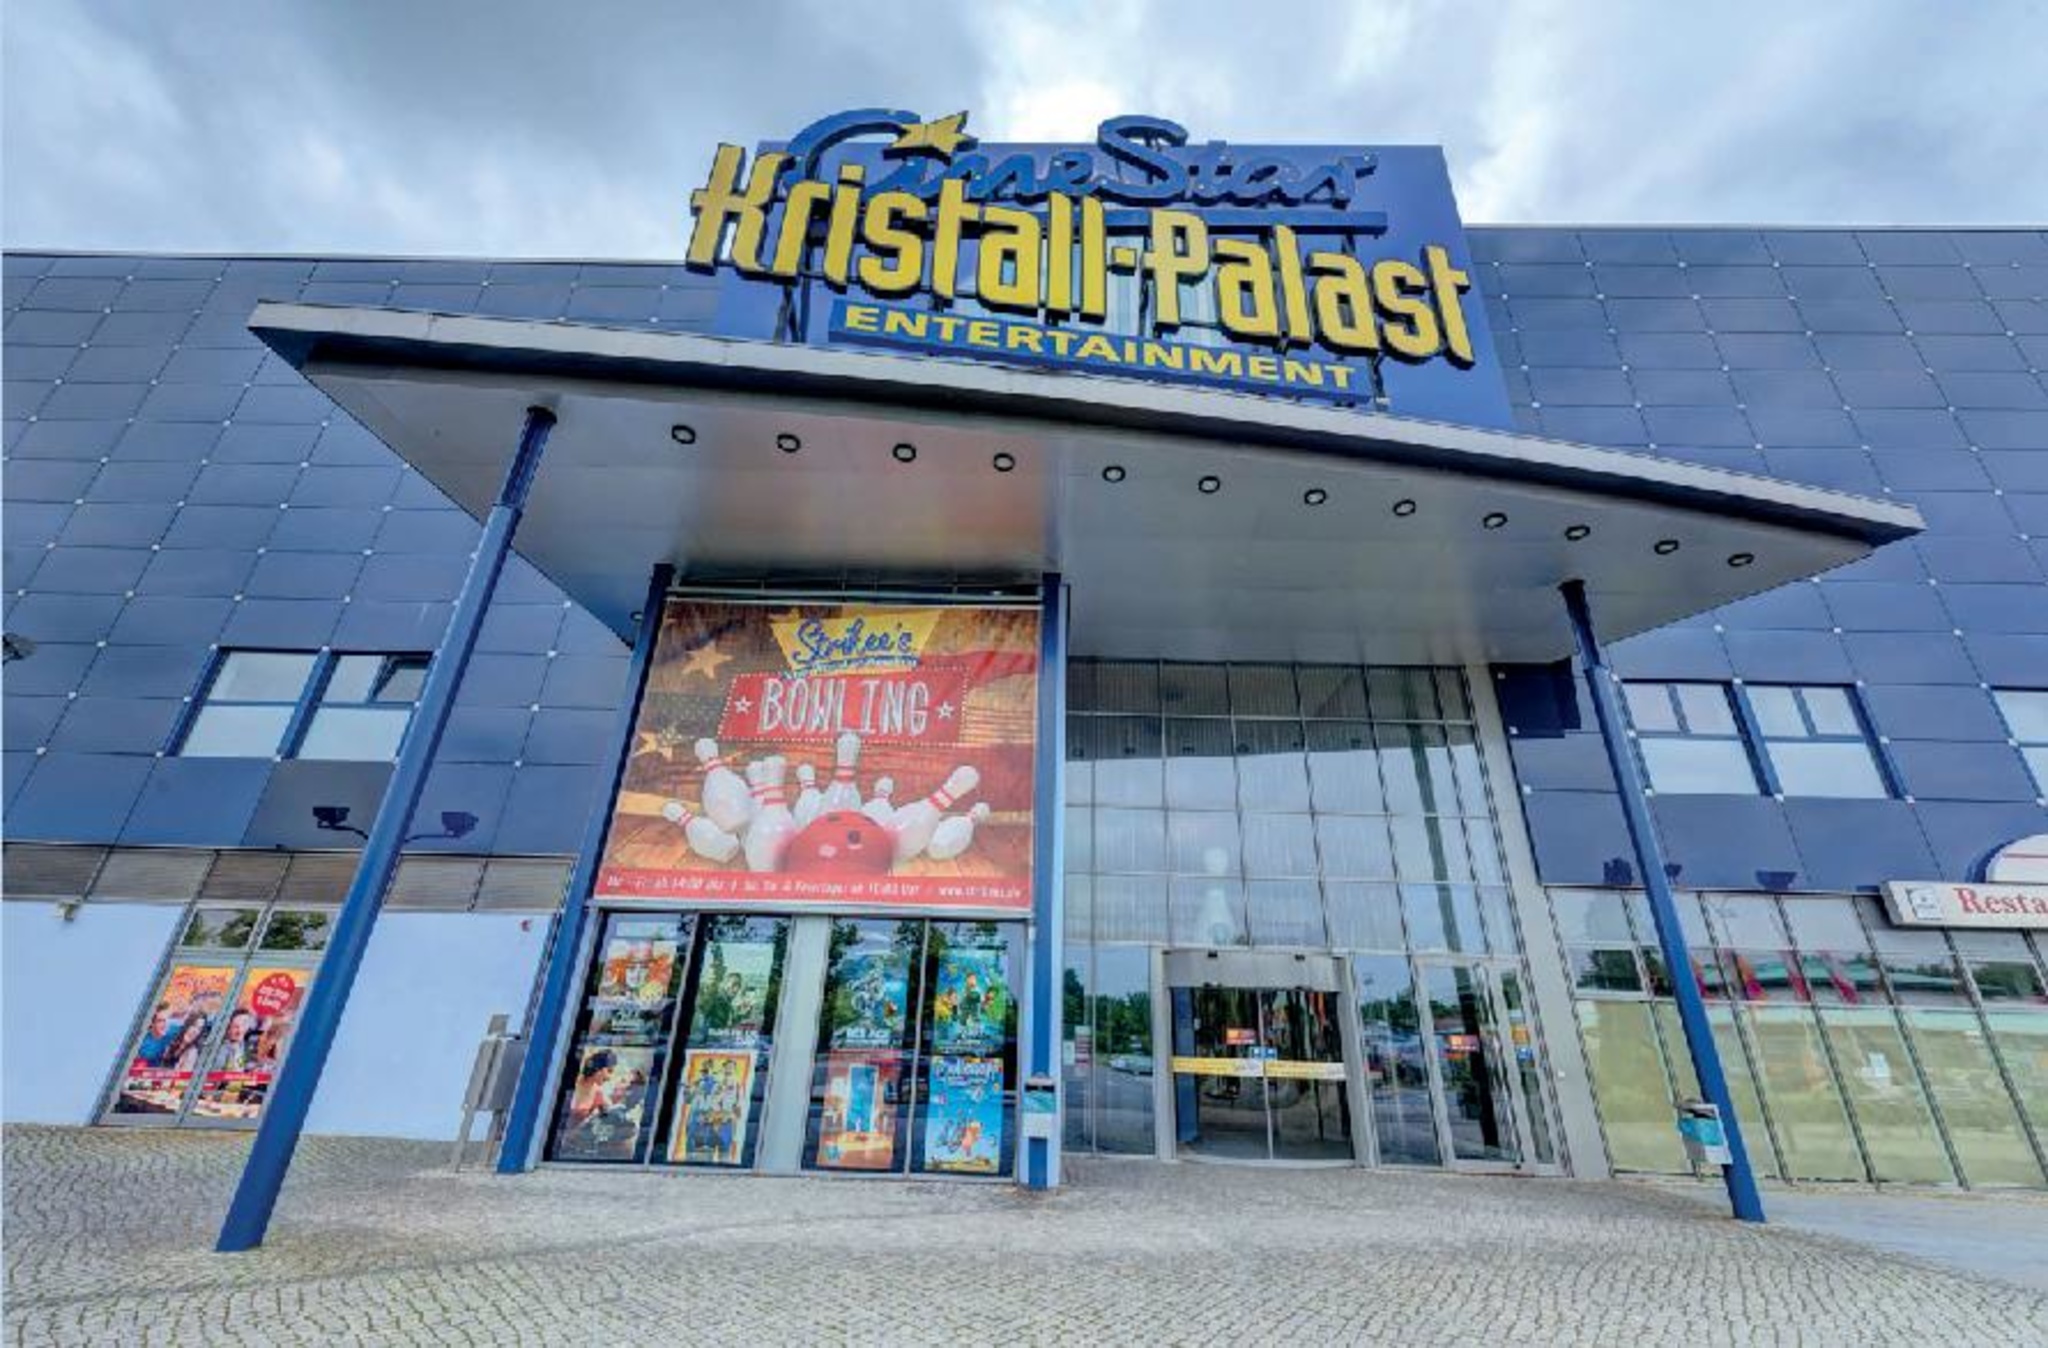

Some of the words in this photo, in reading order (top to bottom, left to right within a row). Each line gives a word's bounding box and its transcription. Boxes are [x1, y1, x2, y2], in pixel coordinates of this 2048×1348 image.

[686, 142, 1475, 368] Kristall-Palast
[845, 306, 1356, 391] ENTERTAINMENT
[759, 677, 929, 736] BOWLING
[1952, 887, 2048, 914] Resta
